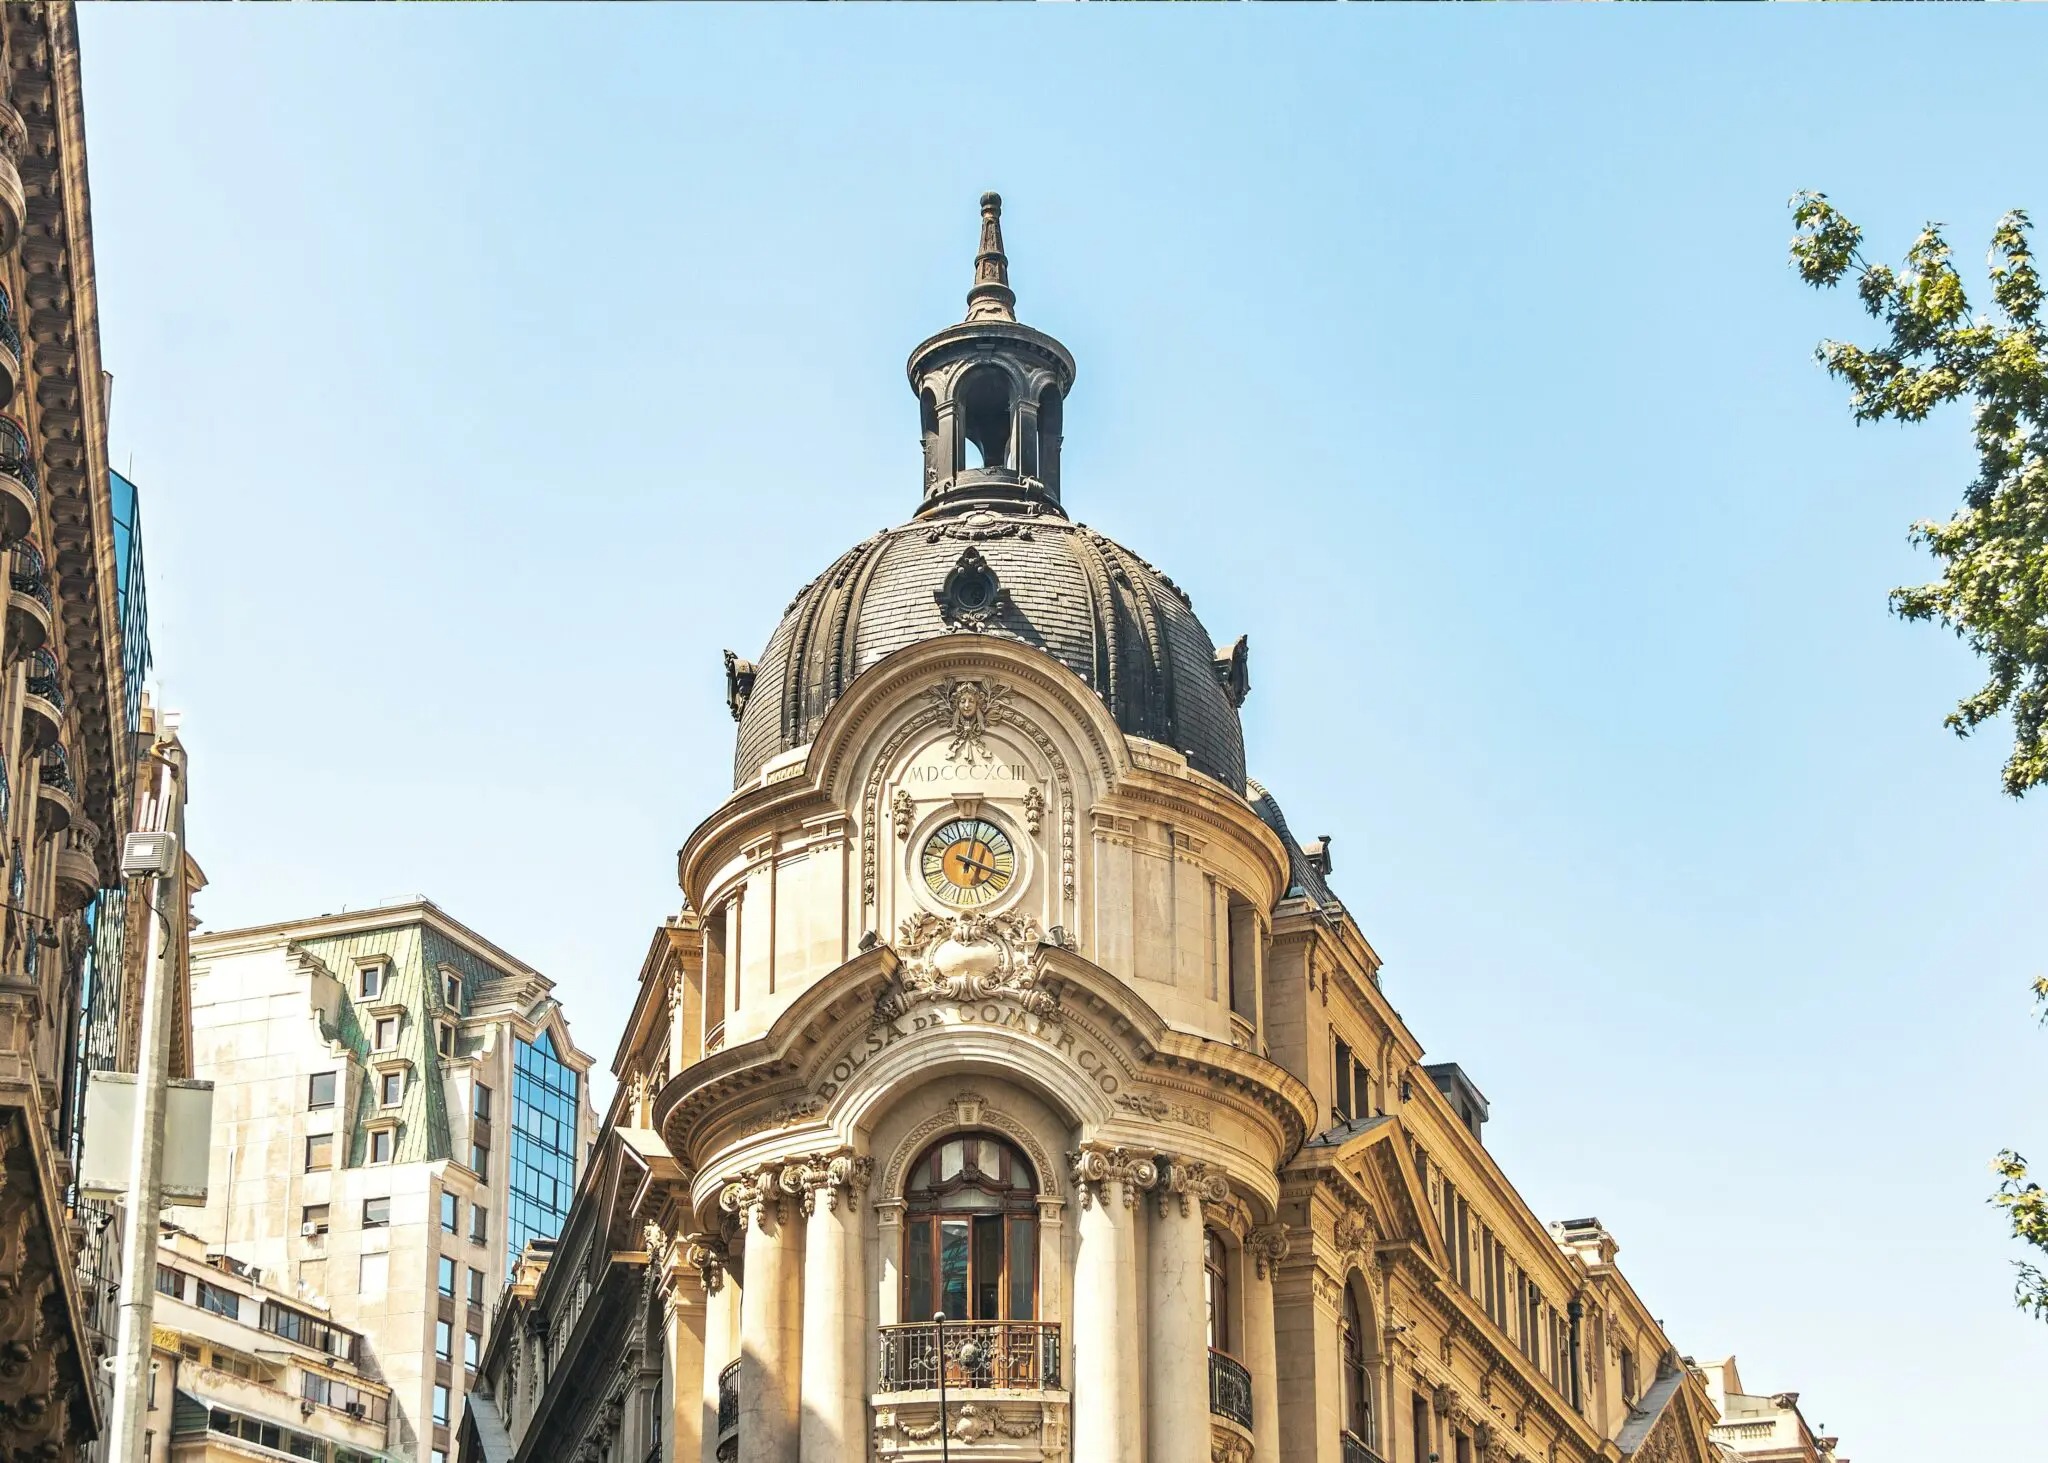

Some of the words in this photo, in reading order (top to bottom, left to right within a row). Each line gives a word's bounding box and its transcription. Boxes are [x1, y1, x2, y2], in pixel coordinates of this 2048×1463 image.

[908, 764, 1026, 783] MDCCCXCIII
[816, 1021, 908, 1104] BOLSA
[912, 1013, 944, 1031] DE
[957, 1003, 1120, 1095] COMERCIO
